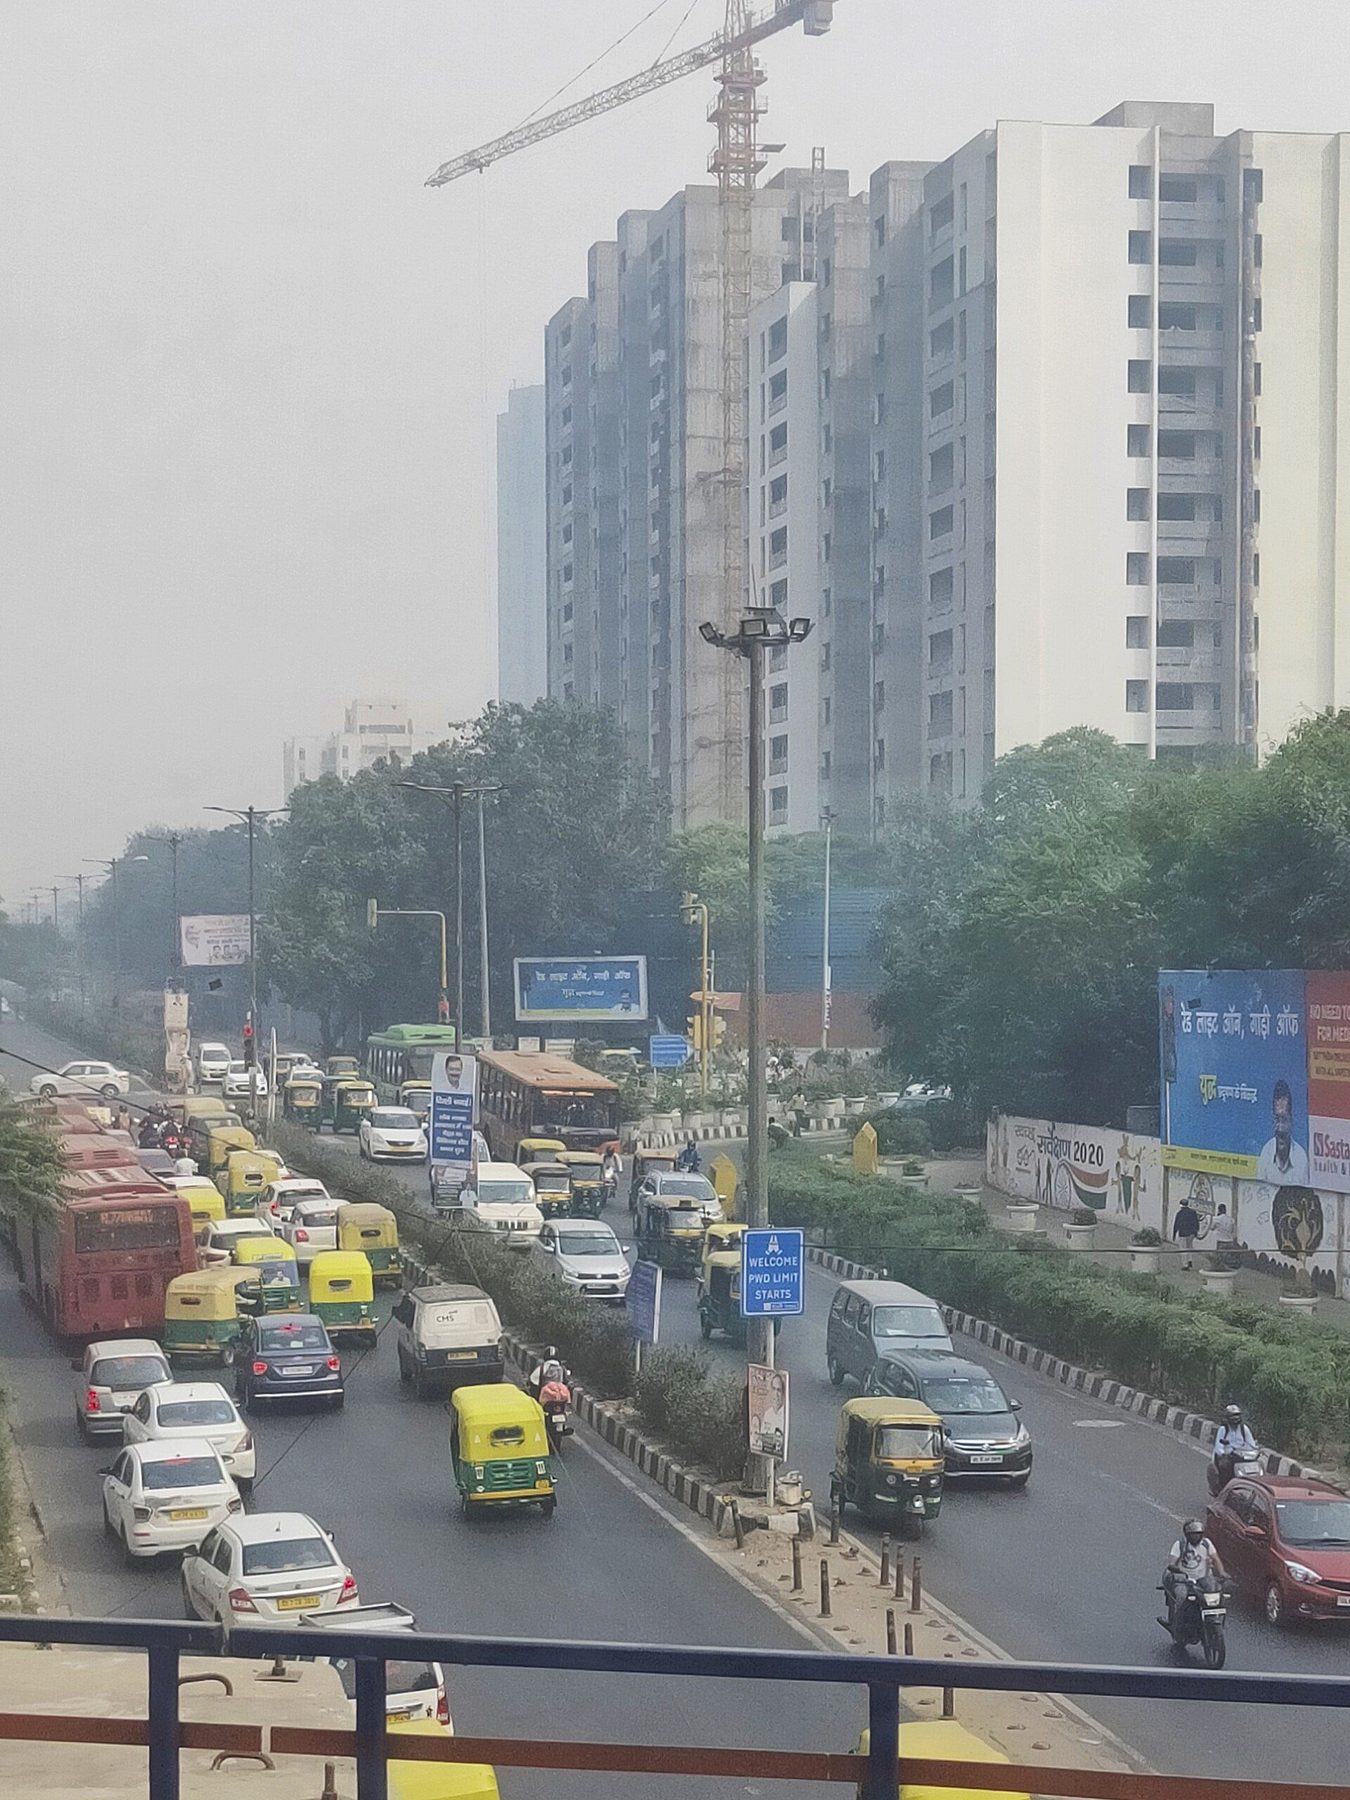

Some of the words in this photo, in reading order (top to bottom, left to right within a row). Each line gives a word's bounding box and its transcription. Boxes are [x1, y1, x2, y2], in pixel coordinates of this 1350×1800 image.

[1195, 1011, 1219, 1039] लाइट
[1073, 1140, 1104, 1167] 2020
[749, 1256, 798, 1268] WELCOME
[748, 1272, 771, 1284] PWD
[773, 1272, 798, 1284] LIMIT
[755, 1288, 792, 1300] STARTS
[436, 1315, 455, 1323] CMS
